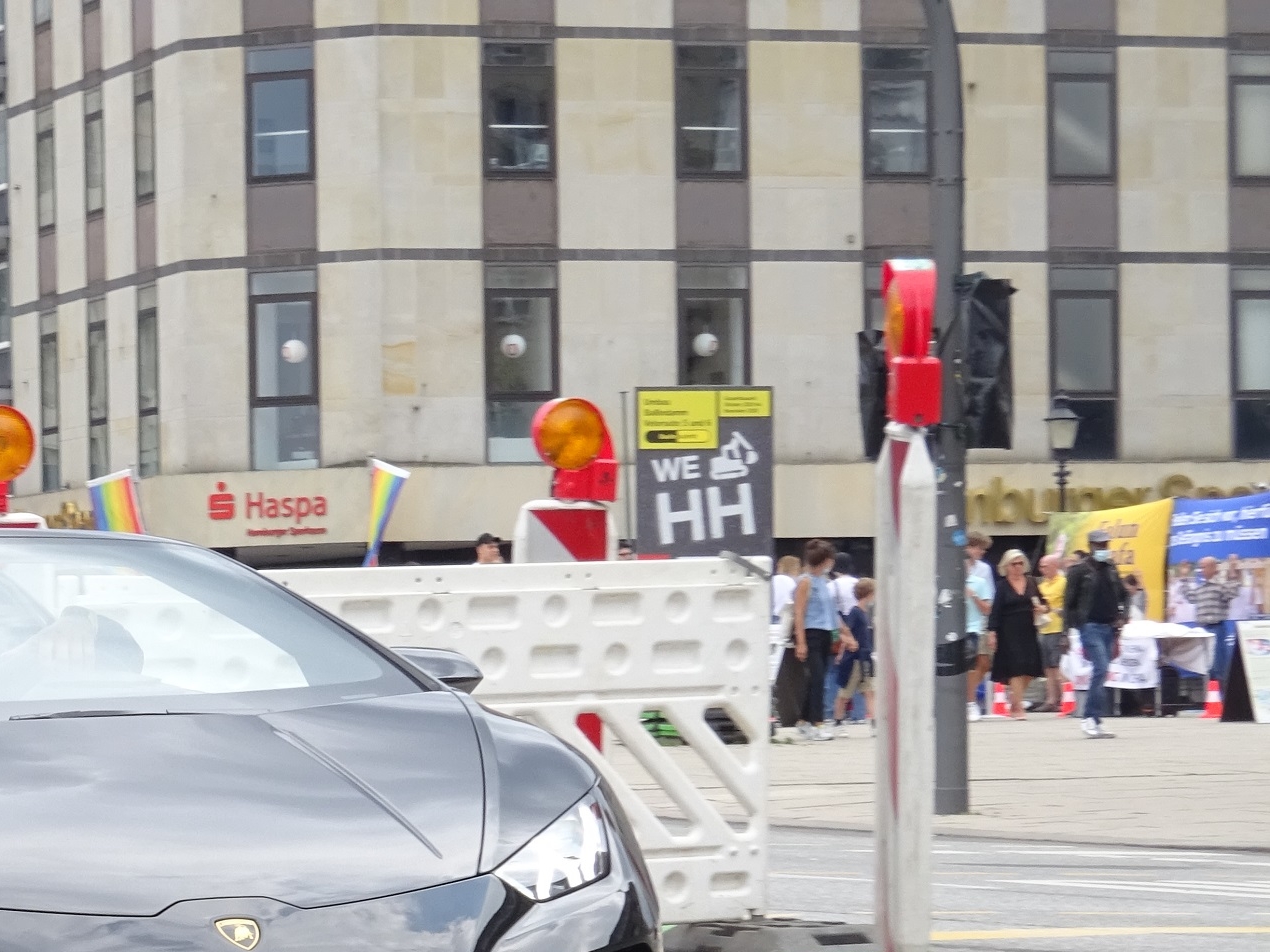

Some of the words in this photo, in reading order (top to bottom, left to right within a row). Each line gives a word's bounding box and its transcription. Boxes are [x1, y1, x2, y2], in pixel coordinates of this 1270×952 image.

[651, 455, 701, 482] WE
[245, 492, 328, 524] Haspa
[656, 483, 756, 545] HH
